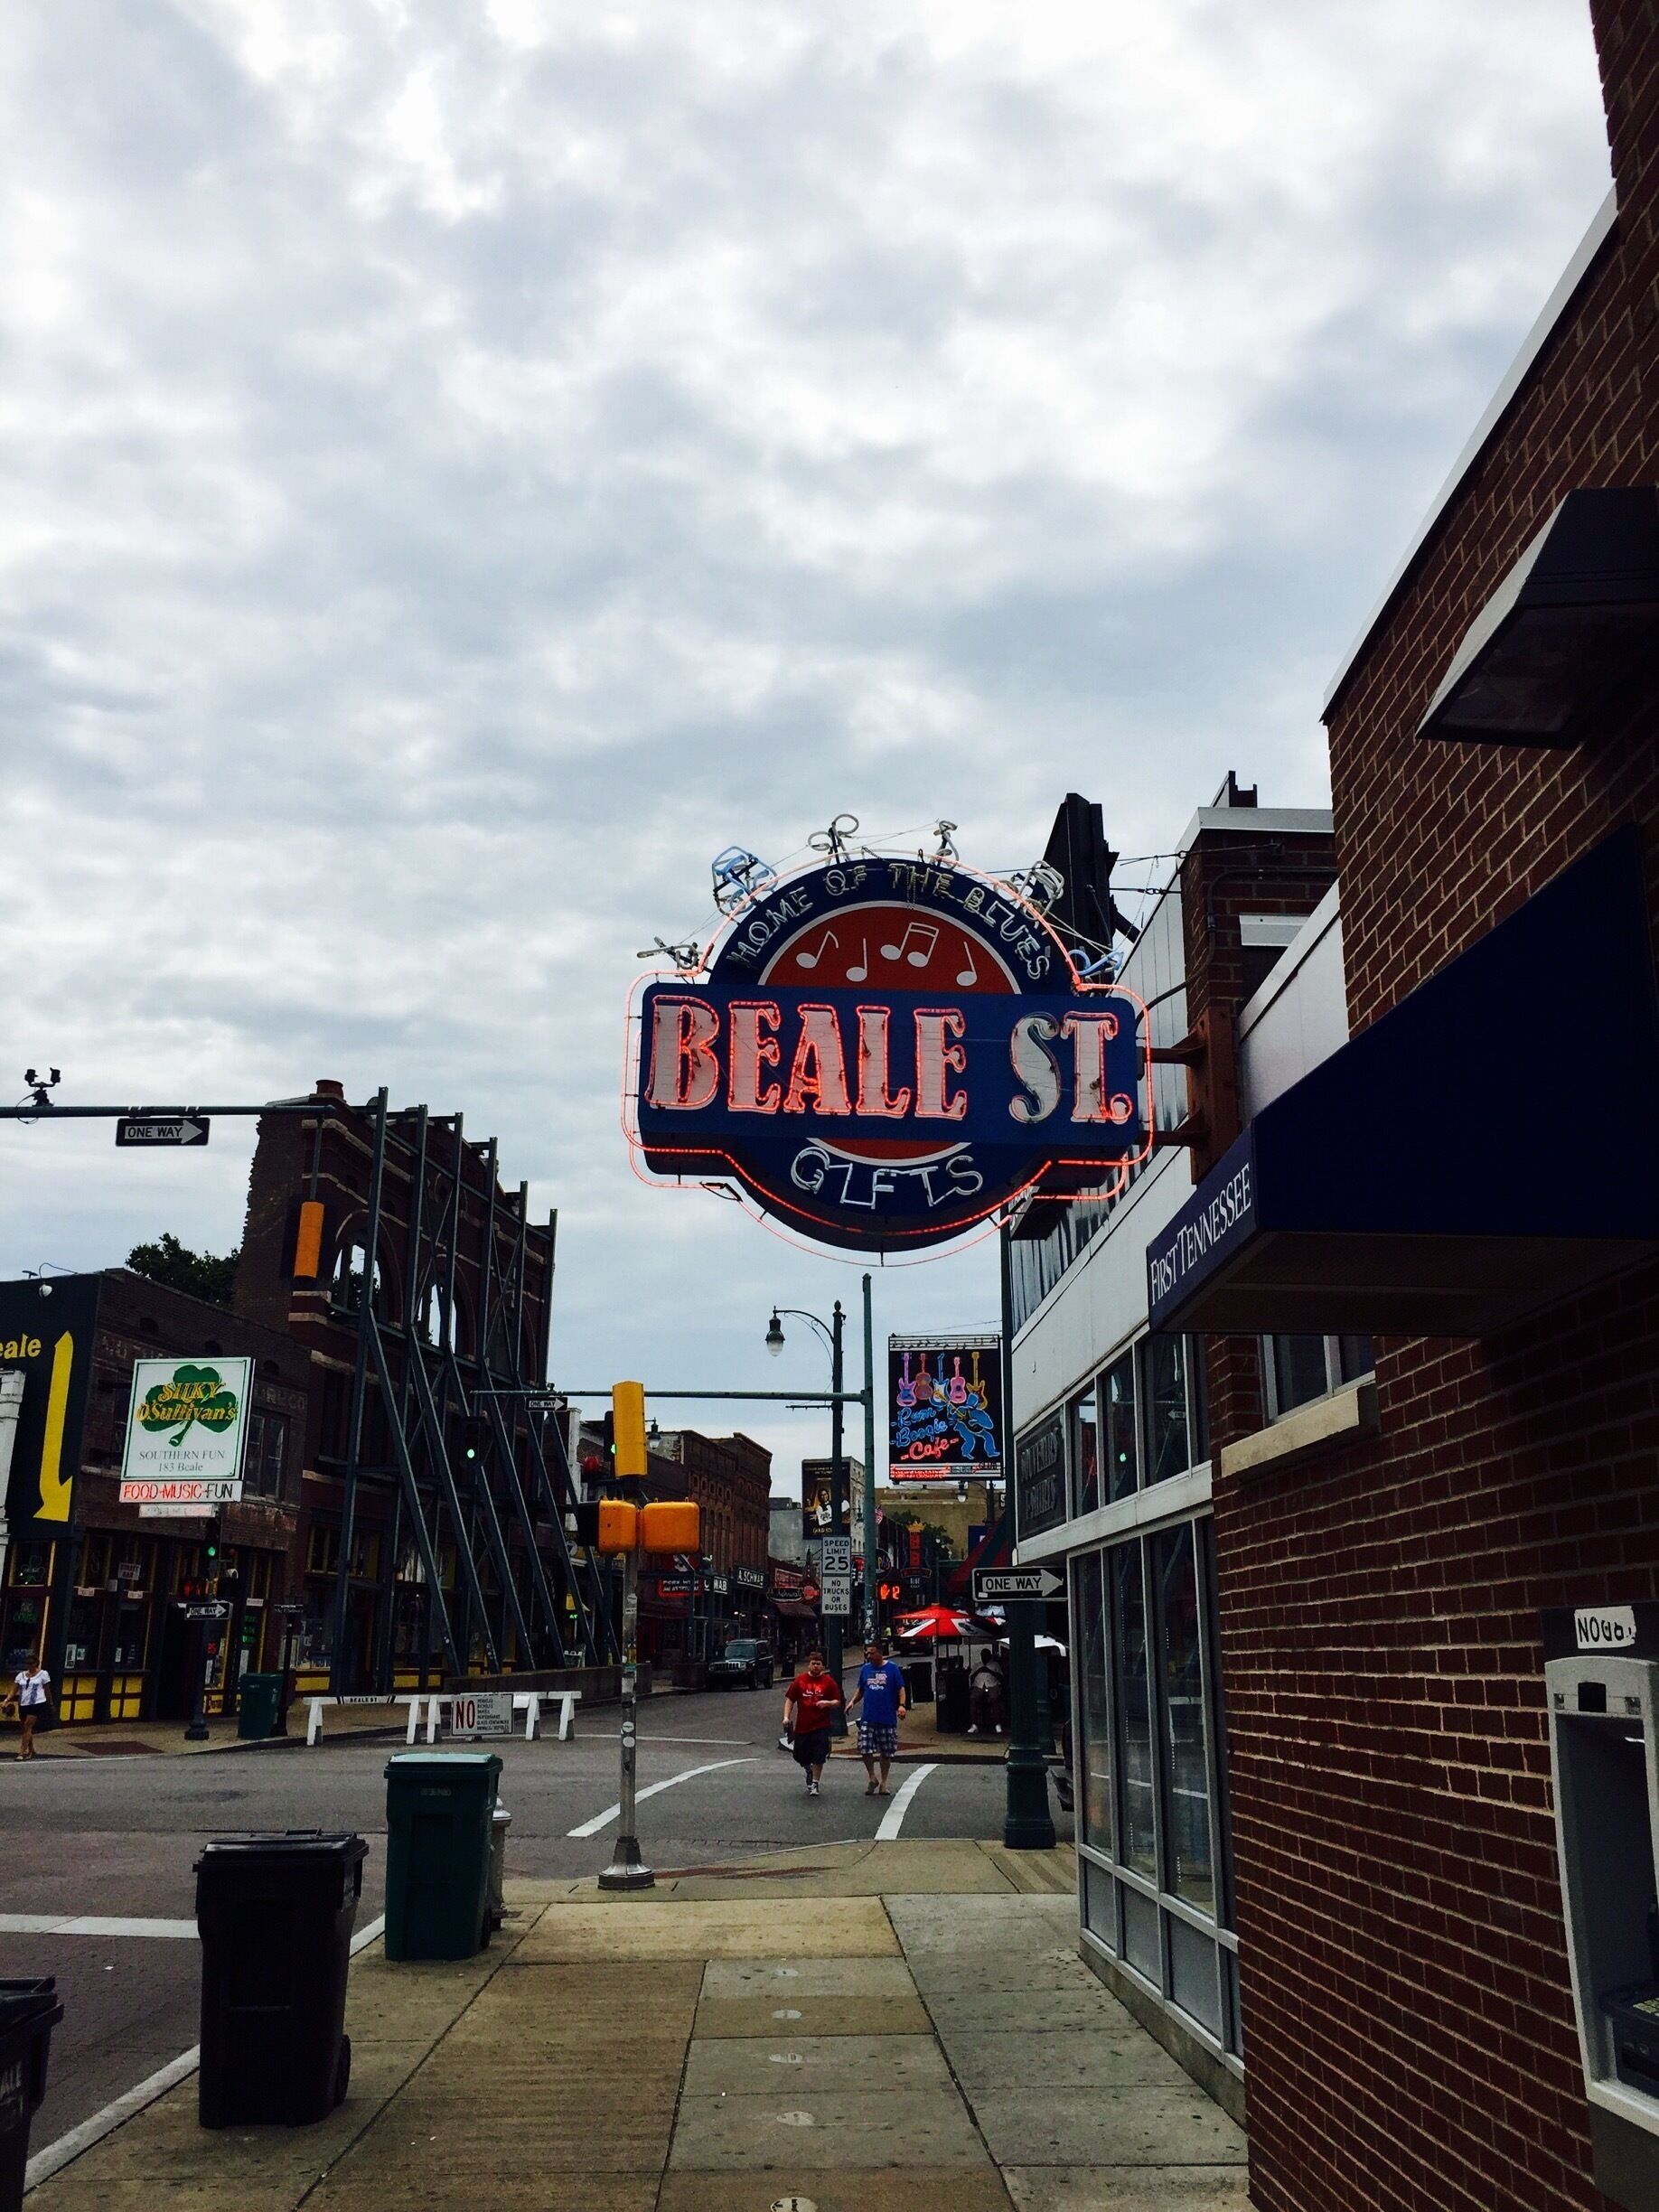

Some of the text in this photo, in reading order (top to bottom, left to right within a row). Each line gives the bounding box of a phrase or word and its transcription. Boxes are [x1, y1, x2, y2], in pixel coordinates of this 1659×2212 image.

[726, 863, 1049, 979] HOME OF THE BLUES
[644, 996, 968, 1121] BEALE
[127, 1127, 183, 1138] ONE WAY
[791, 1147, 983, 1209] GIFTS
[1149, 1162, 1251, 1307] FIRST TENNESSEE
[158, 1382, 226, 1402] SILKY
[898, 1407, 936, 1428] Rum
[896, 1419, 948, 1448] Boogie
[139, 1449, 225, 1460] SOUTHERN FUN
[158, 1462, 203, 1472] 183 Beale
[824, 1556, 848, 1570] 25
[985, 1577, 1042, 1590] ONE WAY
[190, 1607, 216, 1615] ONE WAY
[455, 1700, 476, 1729] NO
